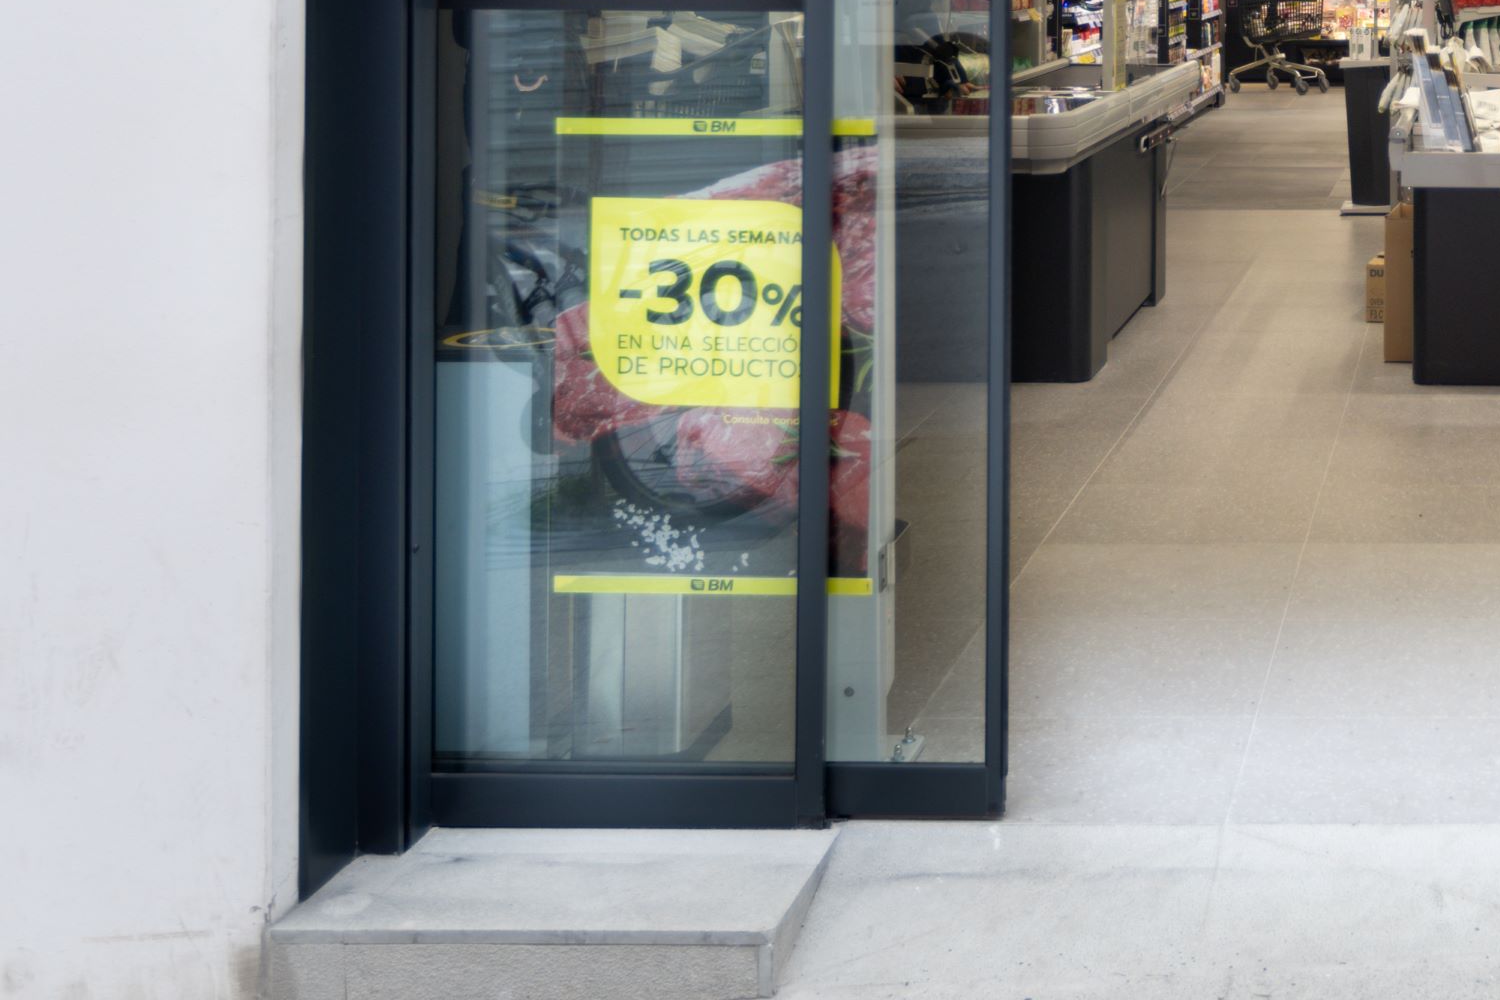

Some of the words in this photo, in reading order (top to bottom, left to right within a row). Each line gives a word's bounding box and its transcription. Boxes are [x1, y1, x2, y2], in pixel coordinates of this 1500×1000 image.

[711, 121, 736, 133] BM
[620, 228, 680, 242] TODAS
[687, 230, 720, 243] LAS
[728, 231, 802, 245] SEMANA
[618, 335, 642, 349] EN
[652, 336, 692, 351] UNA
[702, 333, 798, 353] SELECCIÓ
[618, 356, 648, 374] DE
[660, 358, 801, 378] PRODUCTO
[708, 579, 734, 591] BM
